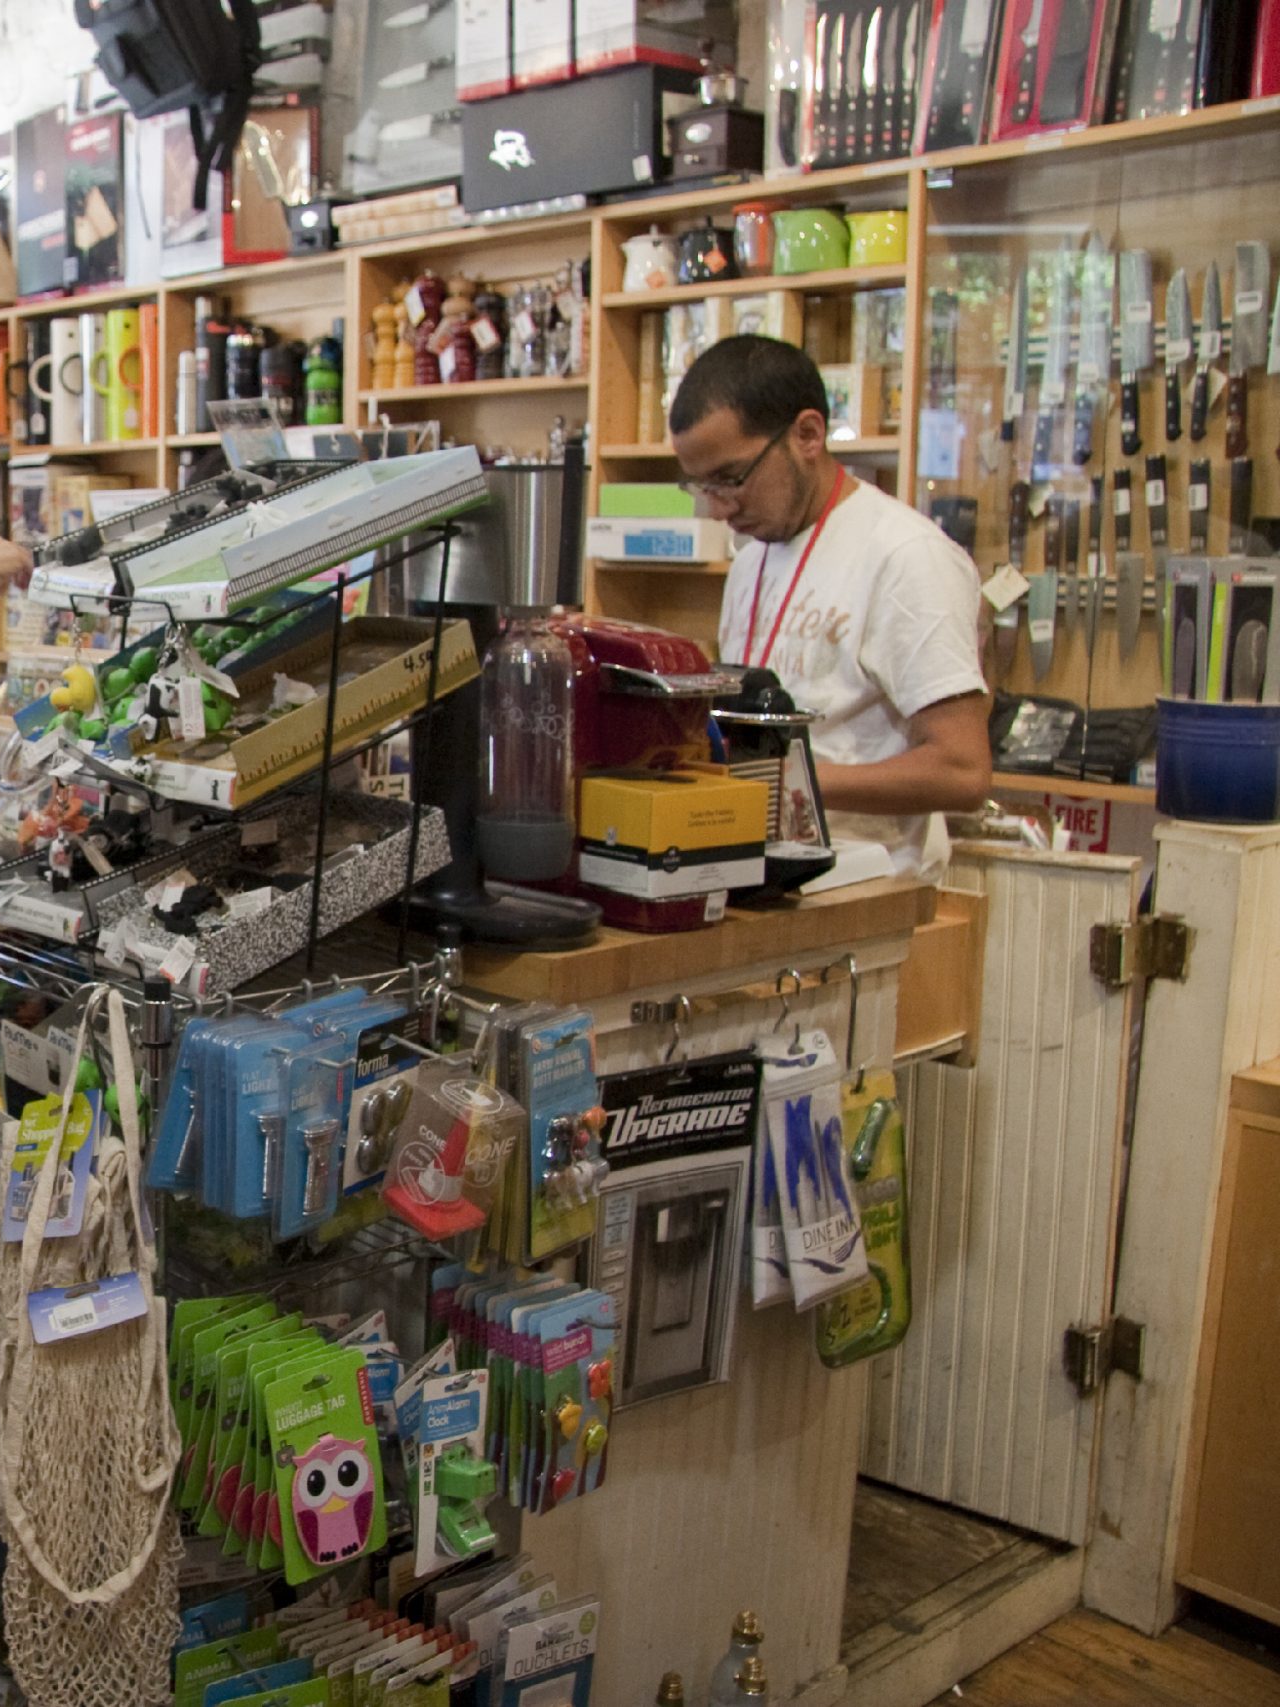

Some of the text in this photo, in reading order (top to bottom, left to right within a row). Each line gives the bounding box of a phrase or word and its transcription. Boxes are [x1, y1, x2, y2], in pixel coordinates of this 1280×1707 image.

[1055, 804, 1098, 835] FIRE
[358, 1054, 389, 1077] forma
[242, 1078, 273, 1095] LIGHT
[420, 1125, 446, 1153] CONE
[465, 1136, 516, 1165] CONE
[802, 1225, 832, 1251] DINE
[836, 1216, 857, 1238] INK
[276, 1402, 324, 1431] LUGGAGE
[326, 1395, 345, 1411] TAG
[427, 1415, 449, 1428] Clock
[513, 1639, 589, 1676] OUCHLETS
